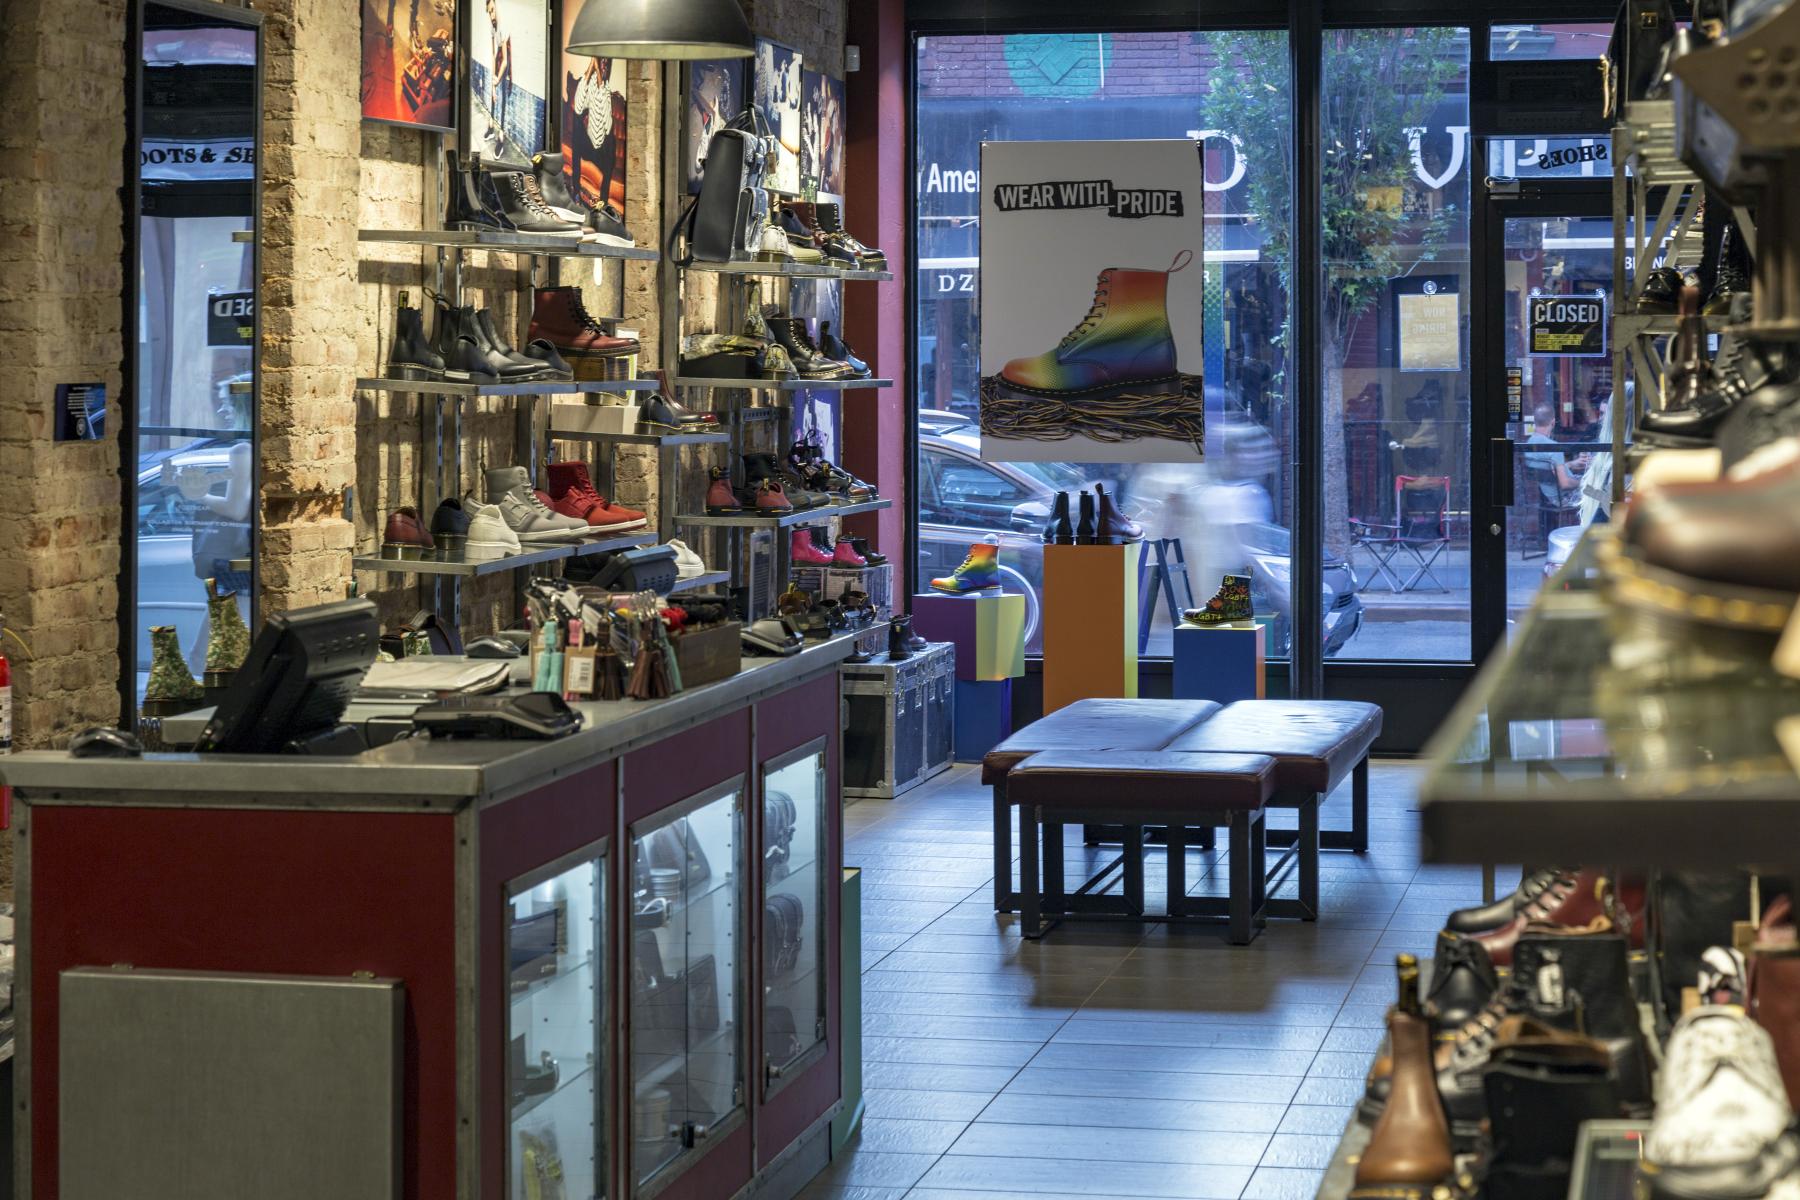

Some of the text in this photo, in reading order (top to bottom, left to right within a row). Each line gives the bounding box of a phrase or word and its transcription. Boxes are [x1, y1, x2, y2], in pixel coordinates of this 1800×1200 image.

[999, 182, 1177, 214] WEAR WITH PRIDE
[1534, 303, 1600, 323] CLOSED
